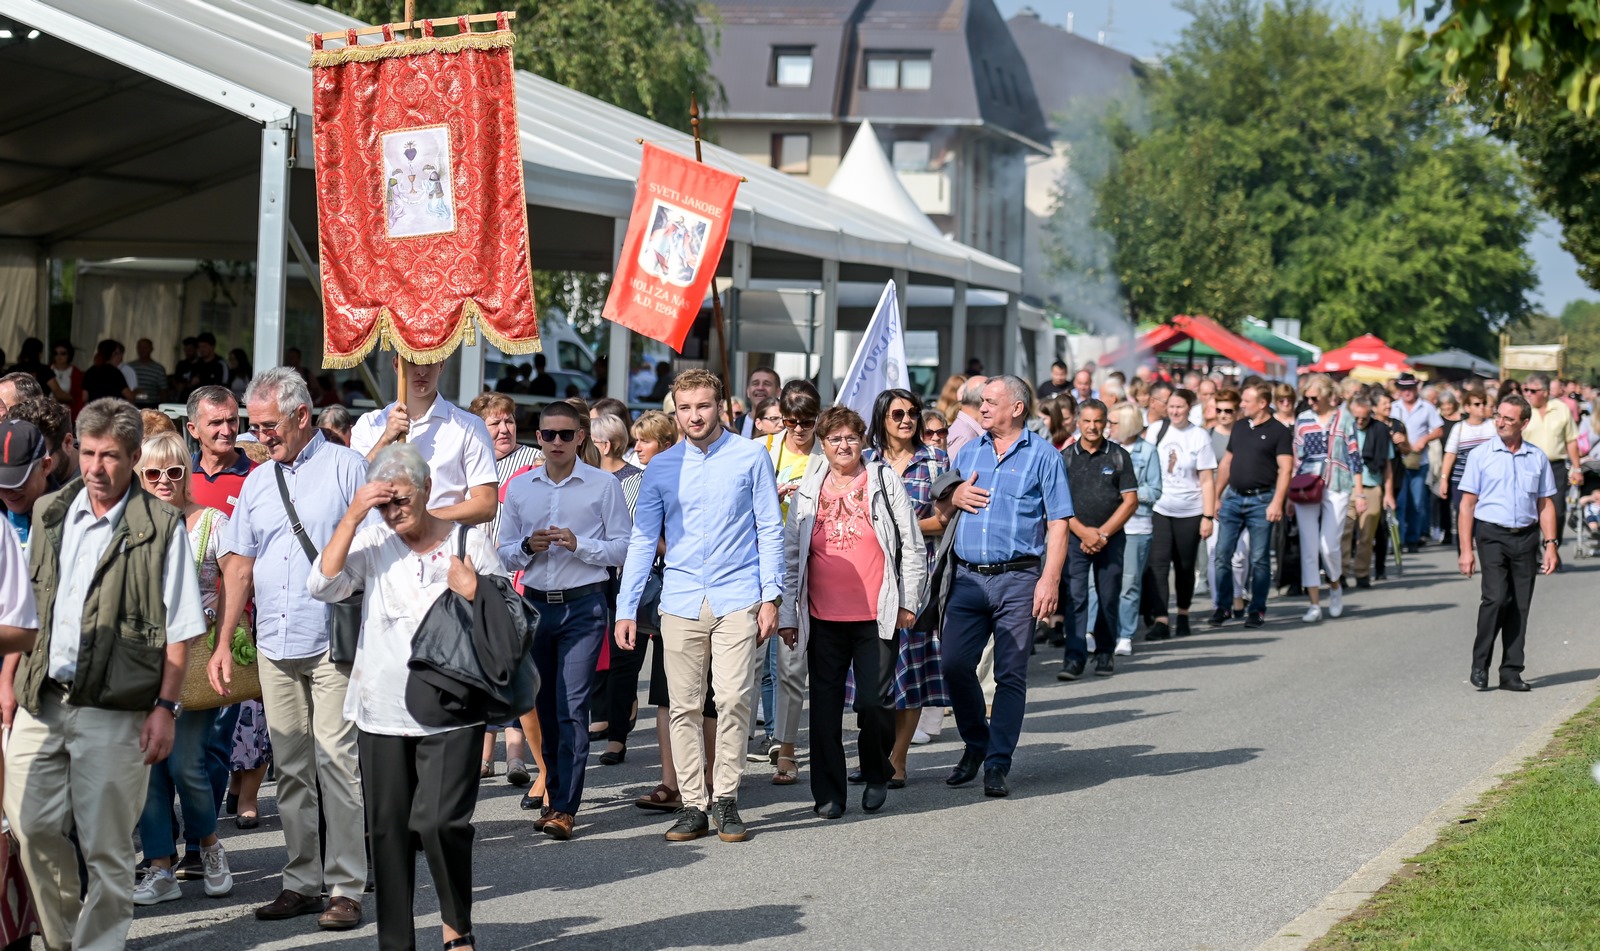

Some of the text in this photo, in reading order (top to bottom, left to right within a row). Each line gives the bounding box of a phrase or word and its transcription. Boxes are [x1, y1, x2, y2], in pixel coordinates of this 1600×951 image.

[649, 182, 723, 218] SVETI JAKOBE
[633, 293, 652, 309] A.D.
[654, 286, 669, 302] ZA
